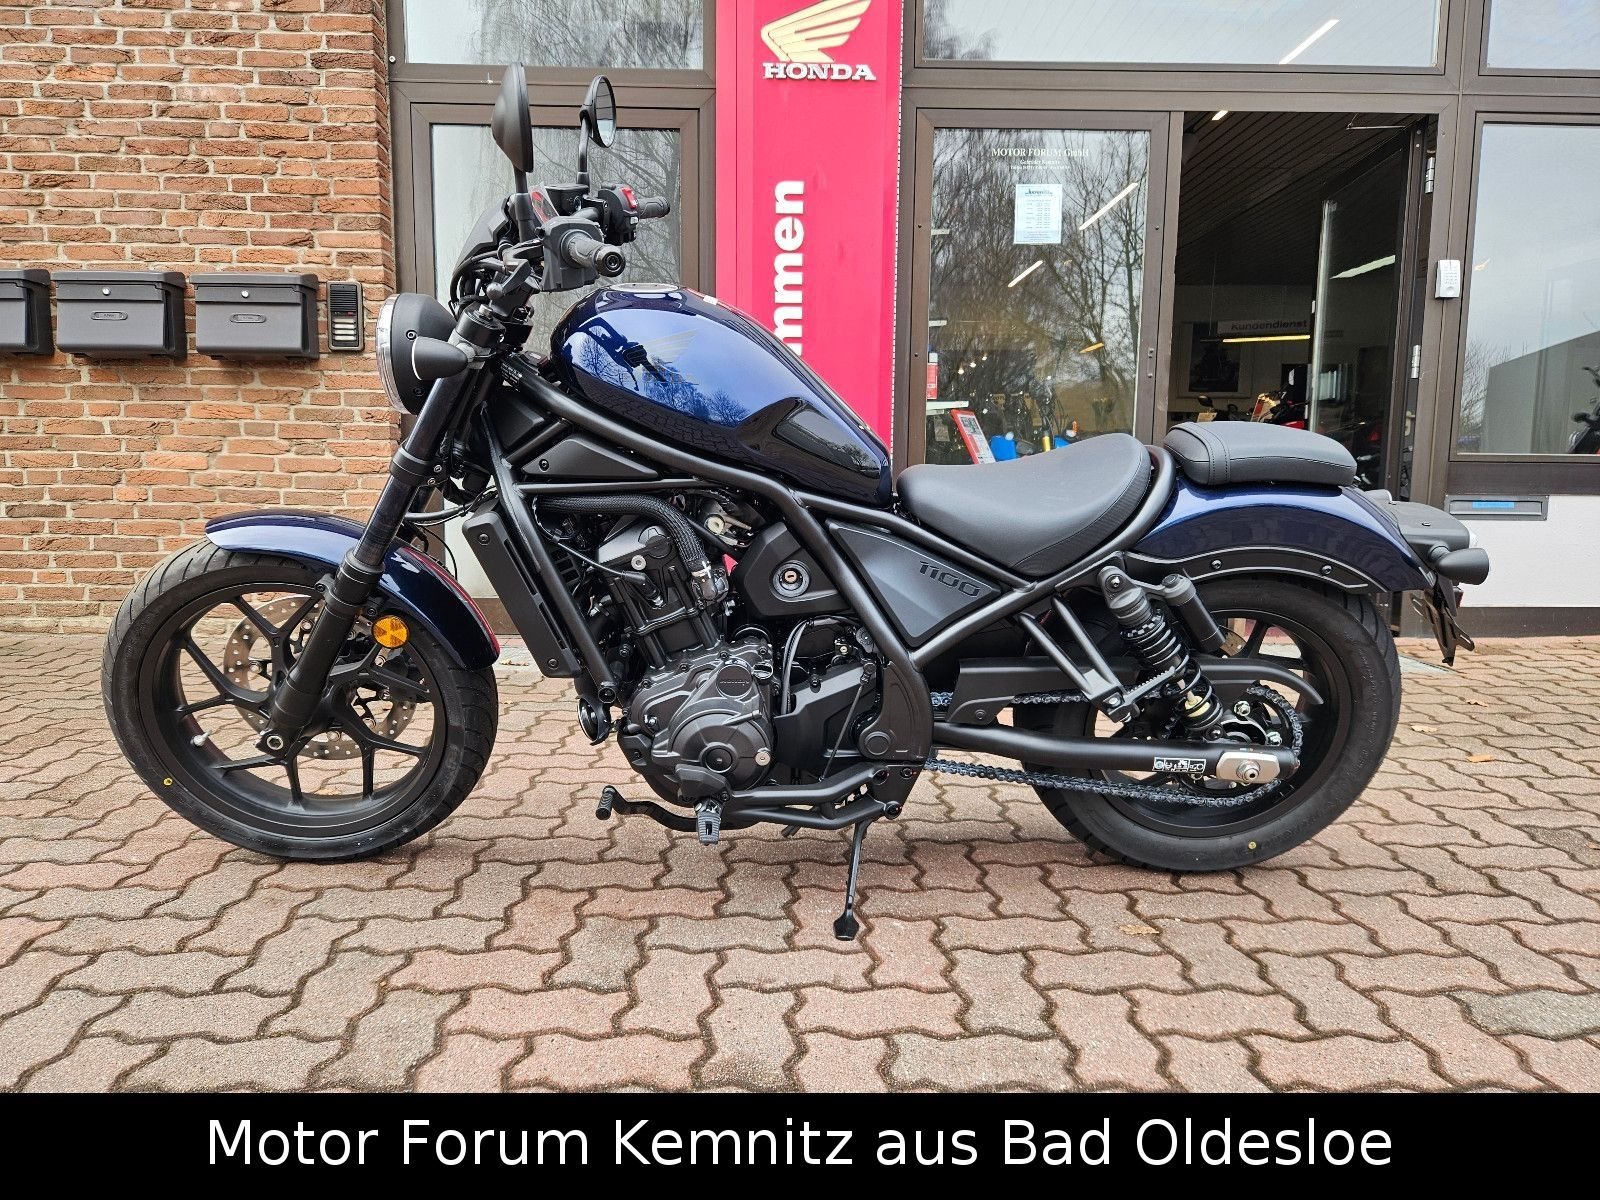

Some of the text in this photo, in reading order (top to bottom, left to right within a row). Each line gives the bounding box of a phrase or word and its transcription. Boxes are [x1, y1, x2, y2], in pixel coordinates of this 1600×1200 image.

[762, 62, 877, 81] HONDA
[992, 148, 1089, 157] MOTOR FORUM GmbH
[919, 560, 981, 597] 1100
